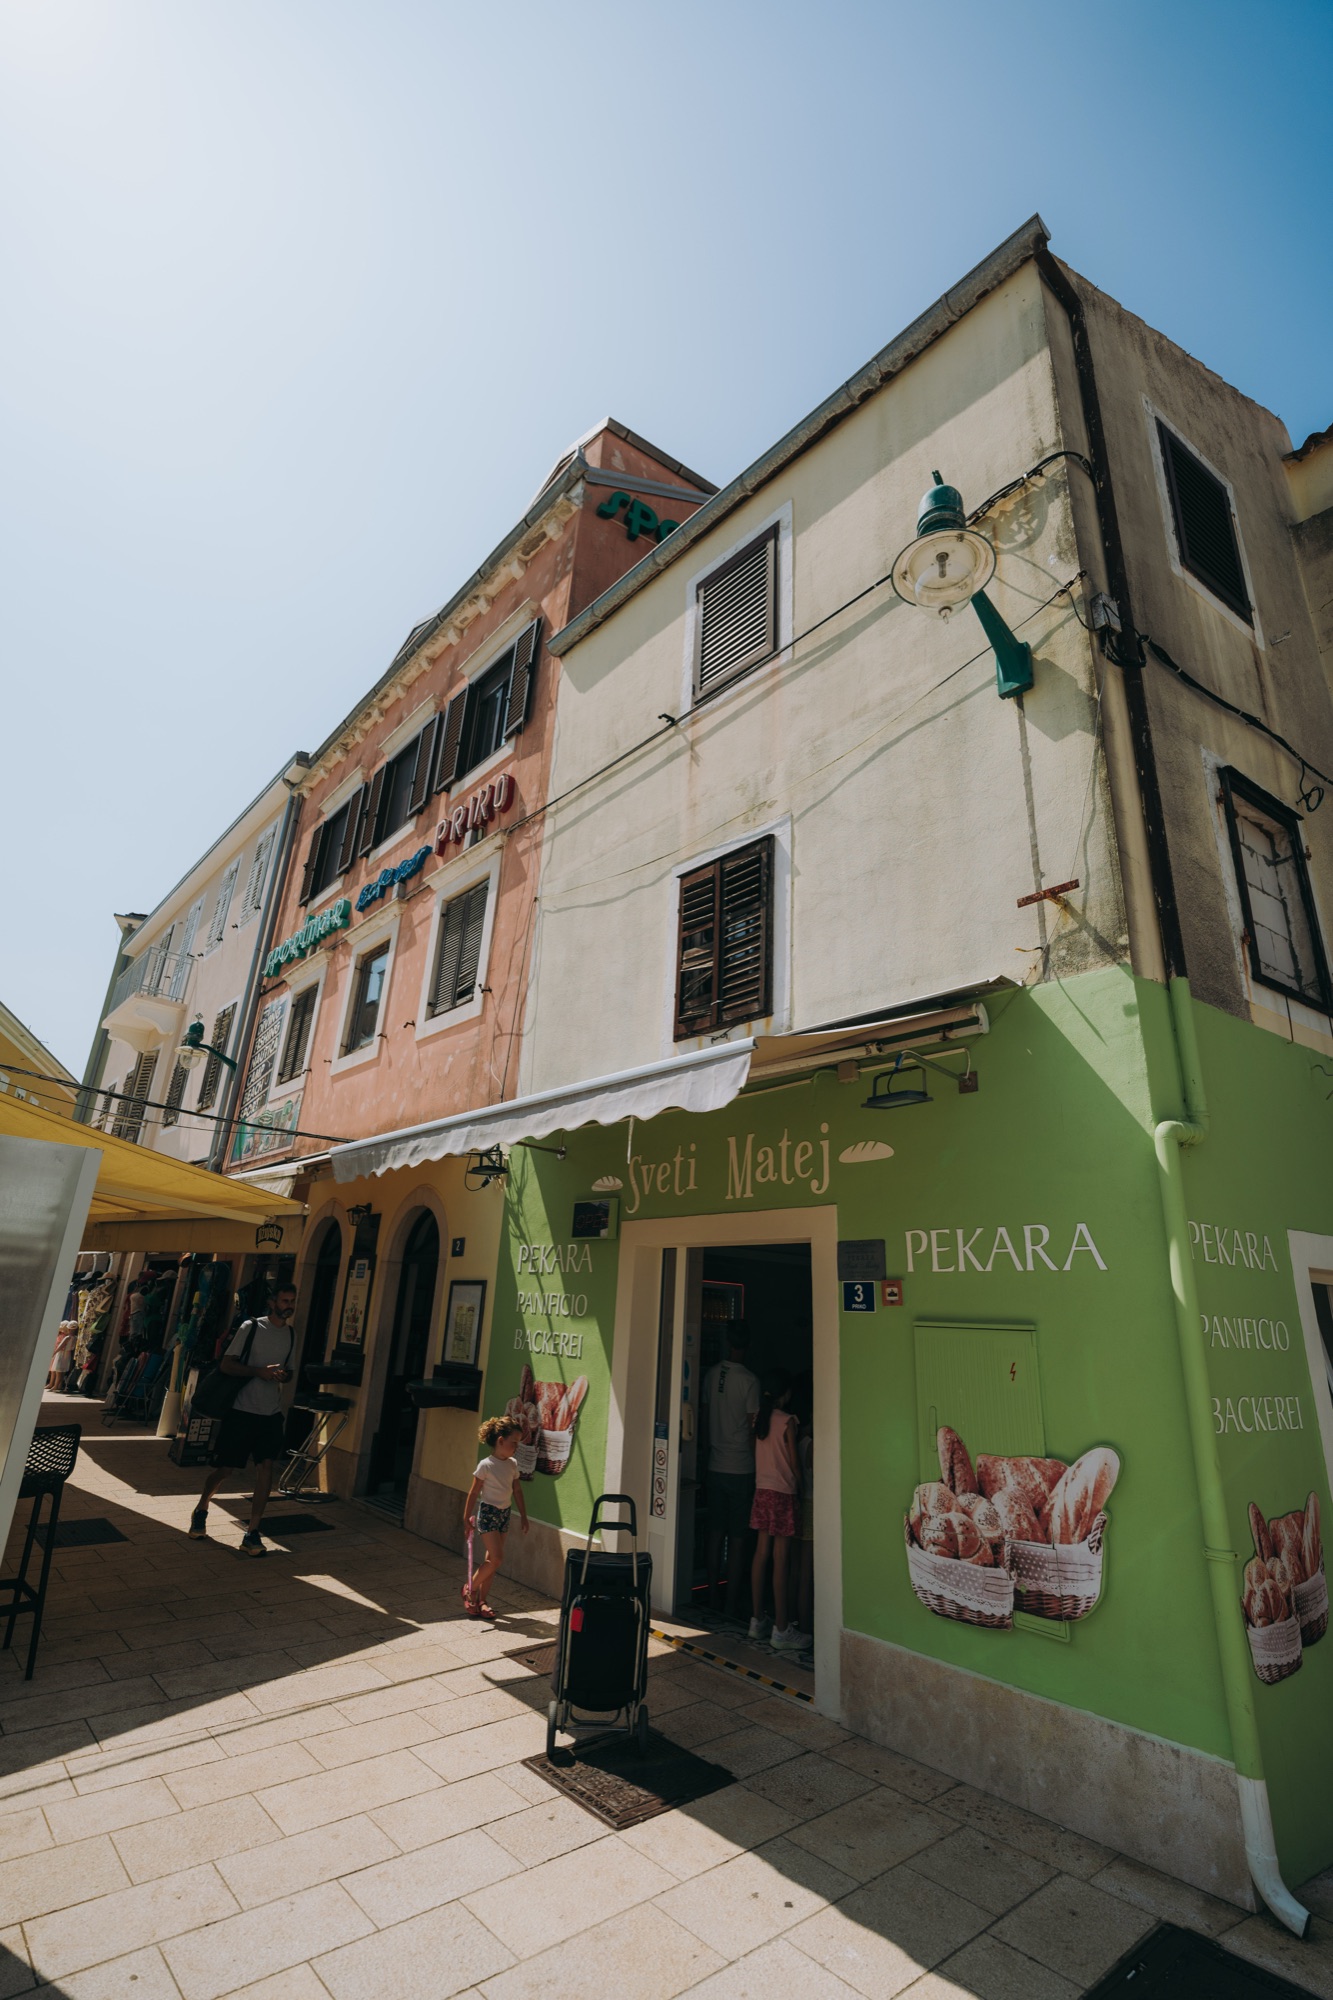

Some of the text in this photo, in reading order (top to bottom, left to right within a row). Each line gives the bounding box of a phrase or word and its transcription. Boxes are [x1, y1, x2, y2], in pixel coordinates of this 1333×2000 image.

[434, 773, 515, 857] PRIKO
[246, 1063, 265, 1086] CAMP
[243, 1081, 264, 1105] BEACH
[625, 1122, 830, 1214] Sveti Matej
[455, 1240, 461, 1251] 2
[517, 1244, 593, 1274] PEKARA
[905, 1223, 1108, 1273] PEKARA
[1187, 1220, 1278, 1272] PEKARA
[516, 1291, 588, 1317] PANIFICIO
[854, 1284, 864, 1302] 3
[513, 1328, 583, 1360] BACKEREI
[1211, 1396, 1303, 1434] BACKEREI
